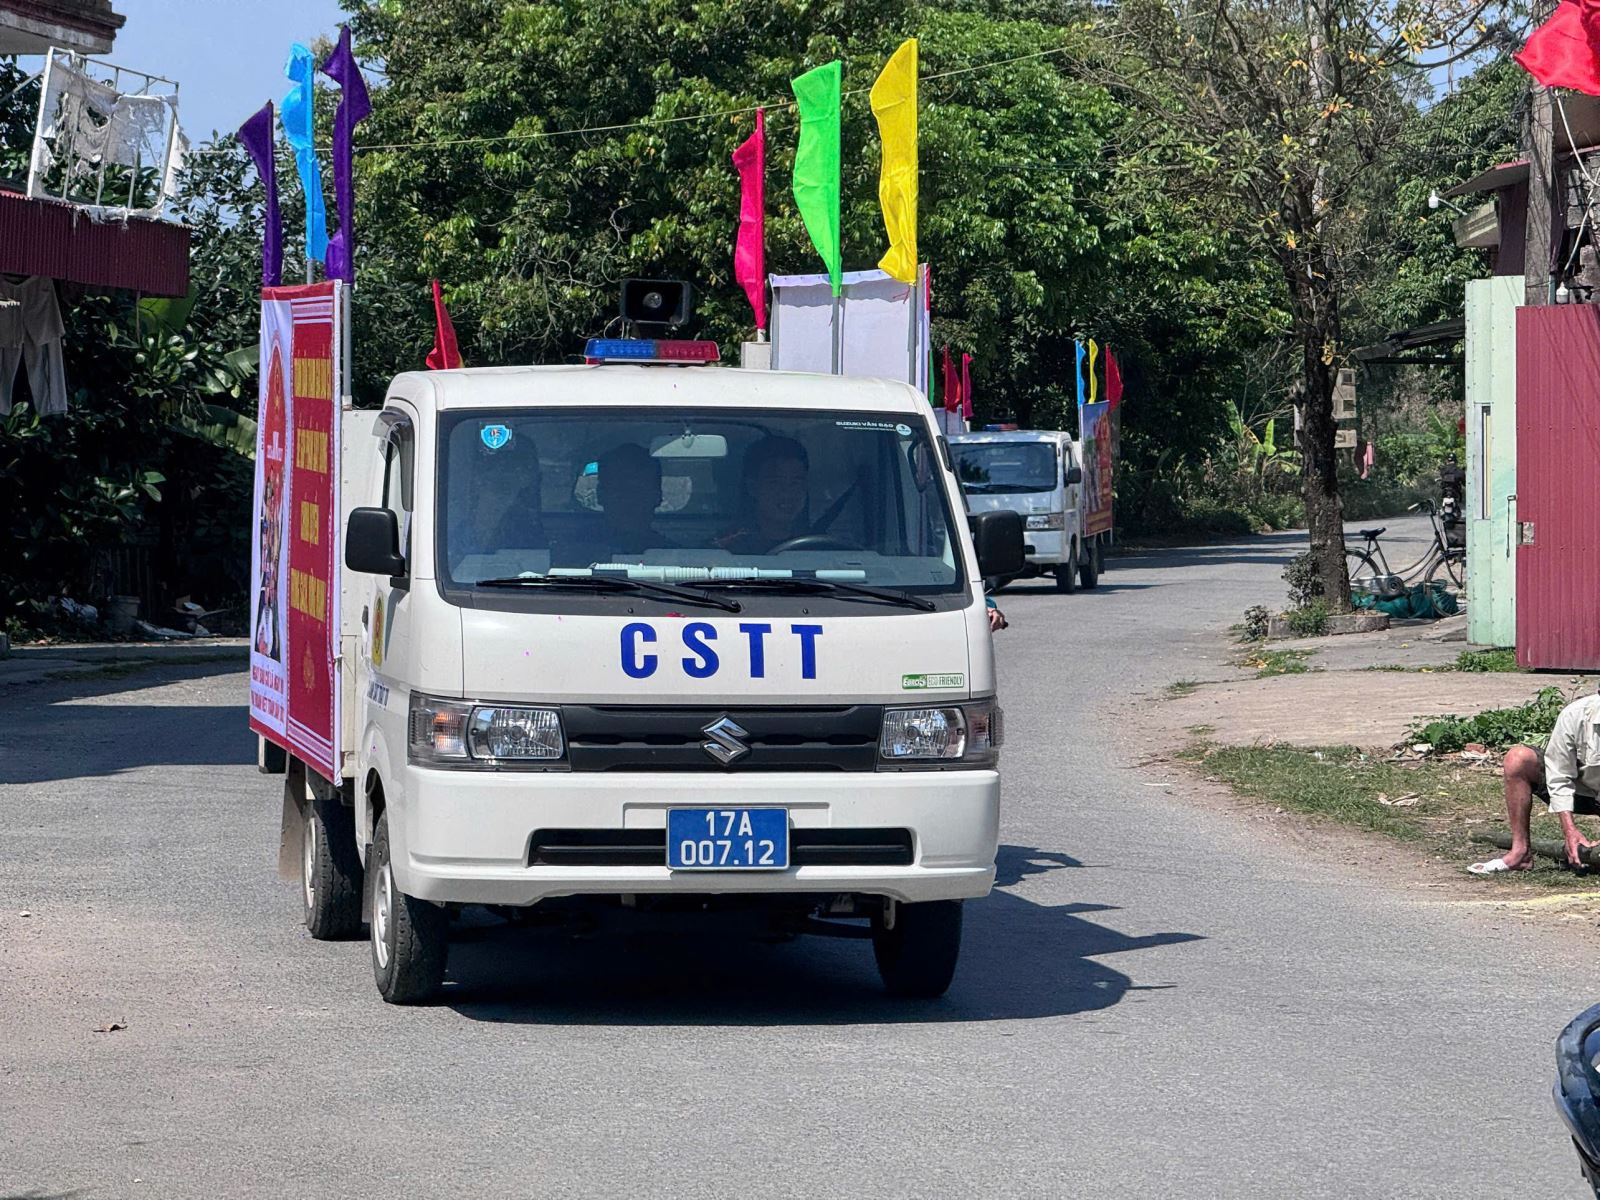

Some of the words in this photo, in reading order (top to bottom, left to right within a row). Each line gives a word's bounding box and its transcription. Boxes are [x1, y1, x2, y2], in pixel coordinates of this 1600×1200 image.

[620, 622, 824, 679] CSTT
[939, 676, 962, 686] FRIENDLY
[706, 811, 753, 837] 17A
[681, 840, 775, 865] 007.12
